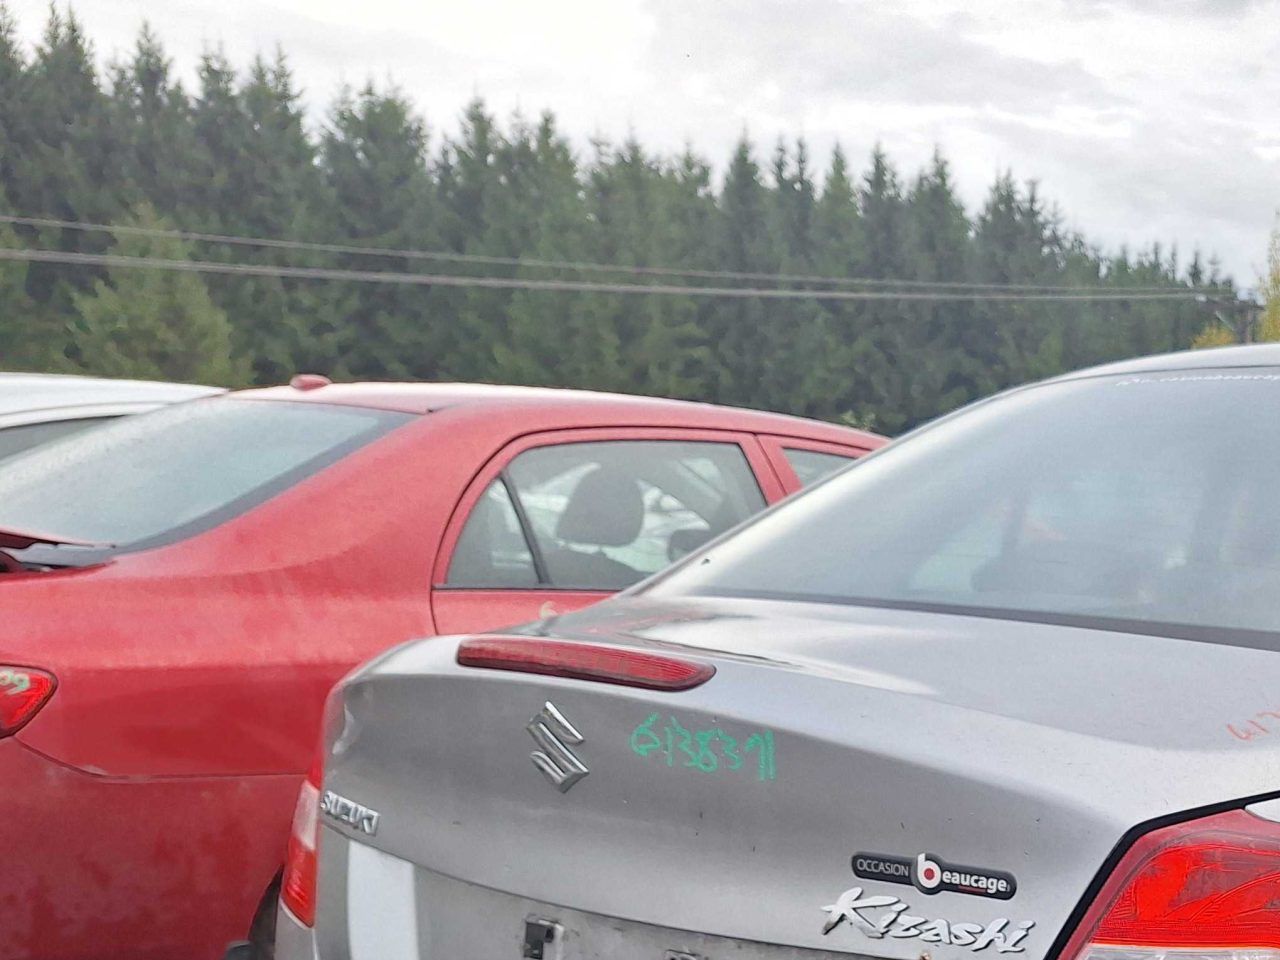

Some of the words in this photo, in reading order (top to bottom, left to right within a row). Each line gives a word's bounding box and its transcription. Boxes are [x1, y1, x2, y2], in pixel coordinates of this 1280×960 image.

[322, 790, 380, 836] SUZUKI
[856, 858, 909, 877] OCCASION
[916, 852, 1008, 894] beaucage
[820, 886, 1036, 954] Kizashi
